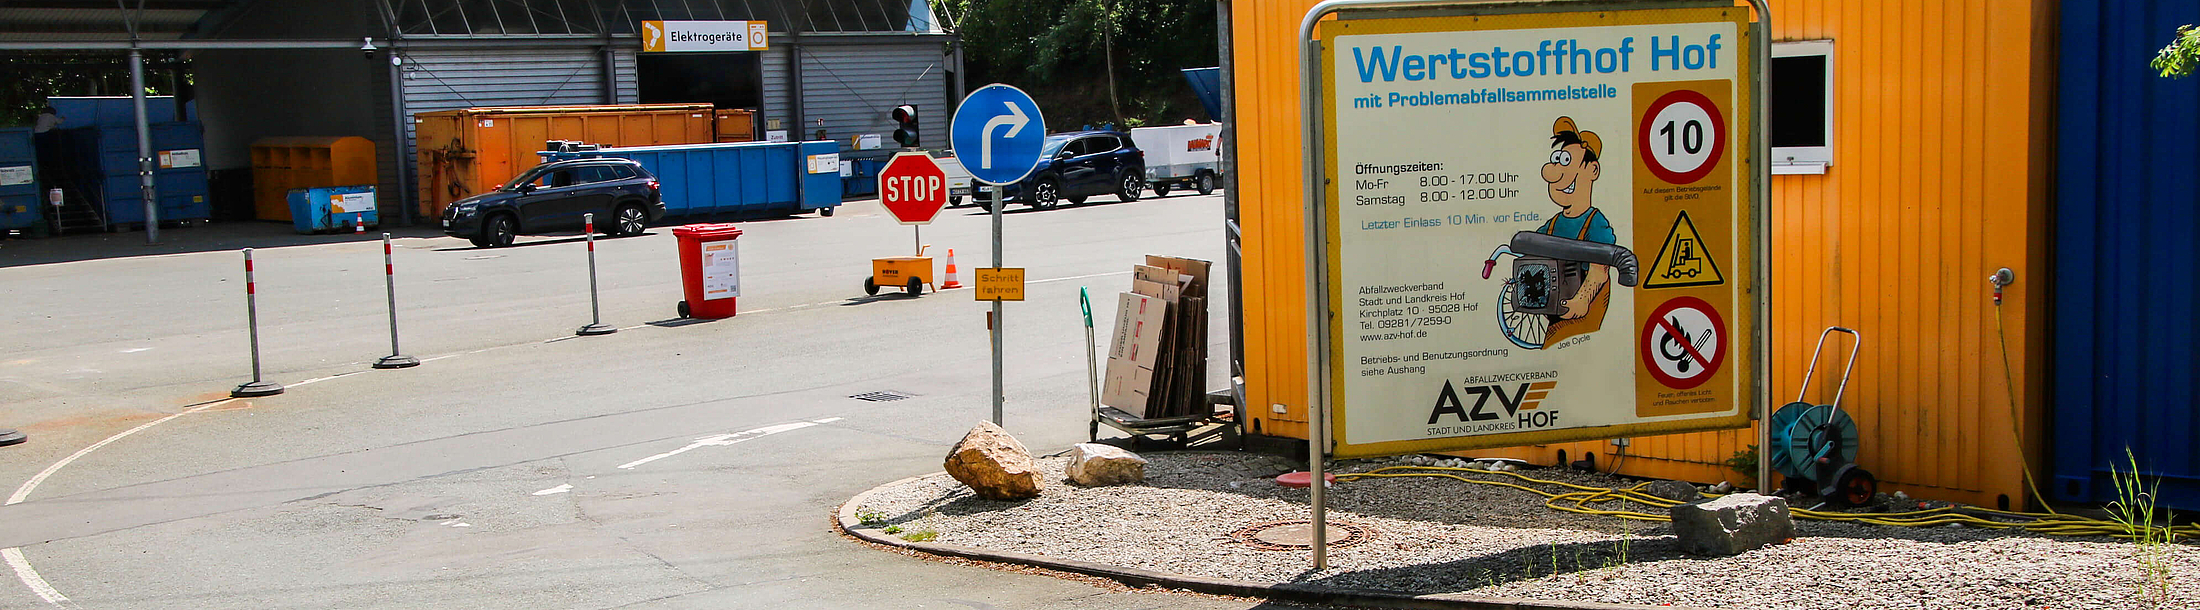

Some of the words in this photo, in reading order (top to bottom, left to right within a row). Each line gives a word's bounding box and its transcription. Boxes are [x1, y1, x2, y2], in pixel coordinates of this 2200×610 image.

[671, 31, 742, 44] Elektrogeräte
[1352, 36, 1634, 83] Wertstoffhof
[1651, 33, 1722, 71] Hof
[1354, 93, 1382, 108] mit
[1388, 84, 1617, 107] Problemabfallsammelstelle
[1660, 120, 1703, 155] 10
[1355, 161, 1443, 175] Öffnungszeiten:
[887, 175, 940, 202] STOP
[1355, 179, 1389, 190] Mo-Fr
[1419, 175, 1449, 187] 8.00
[1460, 172, 1495, 185] 17.00
[1498, 172, 1519, 183] Uhr
[1356, 195, 1405, 207] Samstag
[1420, 191, 1449, 202] 8.00
[1460, 188, 1495, 200] 12.00
[1498, 188, 1519, 199] Uhr
[1361, 219, 1400, 231] Letzter
[1403, 217, 1442, 228] Einlass
[1447, 214, 1462, 226] 10
[1465, 213, 1488, 225] Min.
[1493, 214, 1510, 223] vor
[1513, 211, 1543, 222] Ende.
[981, 274, 1019, 282] Schritt
[982, 285, 1019, 294] fahren
[1359, 282, 1444, 295] Abfallzweckverband
[1359, 297, 1383, 306] Stadt
[1386, 296, 1402, 305] und
[1405, 293, 1447, 304] Landkreis
[1450, 292, 1466, 301] Hof
[1359, 307, 1403, 319] Kirchplatz
[1406, 305, 1420, 315] 10
[1428, 303, 1461, 314] 95028
[1463, 302, 1479, 311] Hof
[1360, 321, 1375, 330] Tel.
[1377, 316, 1452, 329] 09281/7259-0
[1360, 329, 1428, 342] www.azv-hof.de
[1557, 341, 1571, 349] Joe
[1360, 355, 1401, 365] Betriebs-
[1403, 352, 1420, 362] und
[1422, 348, 1509, 361] Benutzungsordnung
[1361, 366, 1385, 377] siehe
[1387, 365, 1426, 375] Aushang
[1463, 370, 1558, 385] ABFALLZWECKVERBAND
[1427, 378, 1531, 424] AZV
[1518, 410, 1559, 428] HOF
[1427, 427, 1451, 436] STADT
[1452, 425, 1472, 434] UND
[1473, 422, 1515, 433] LANDKREIS
